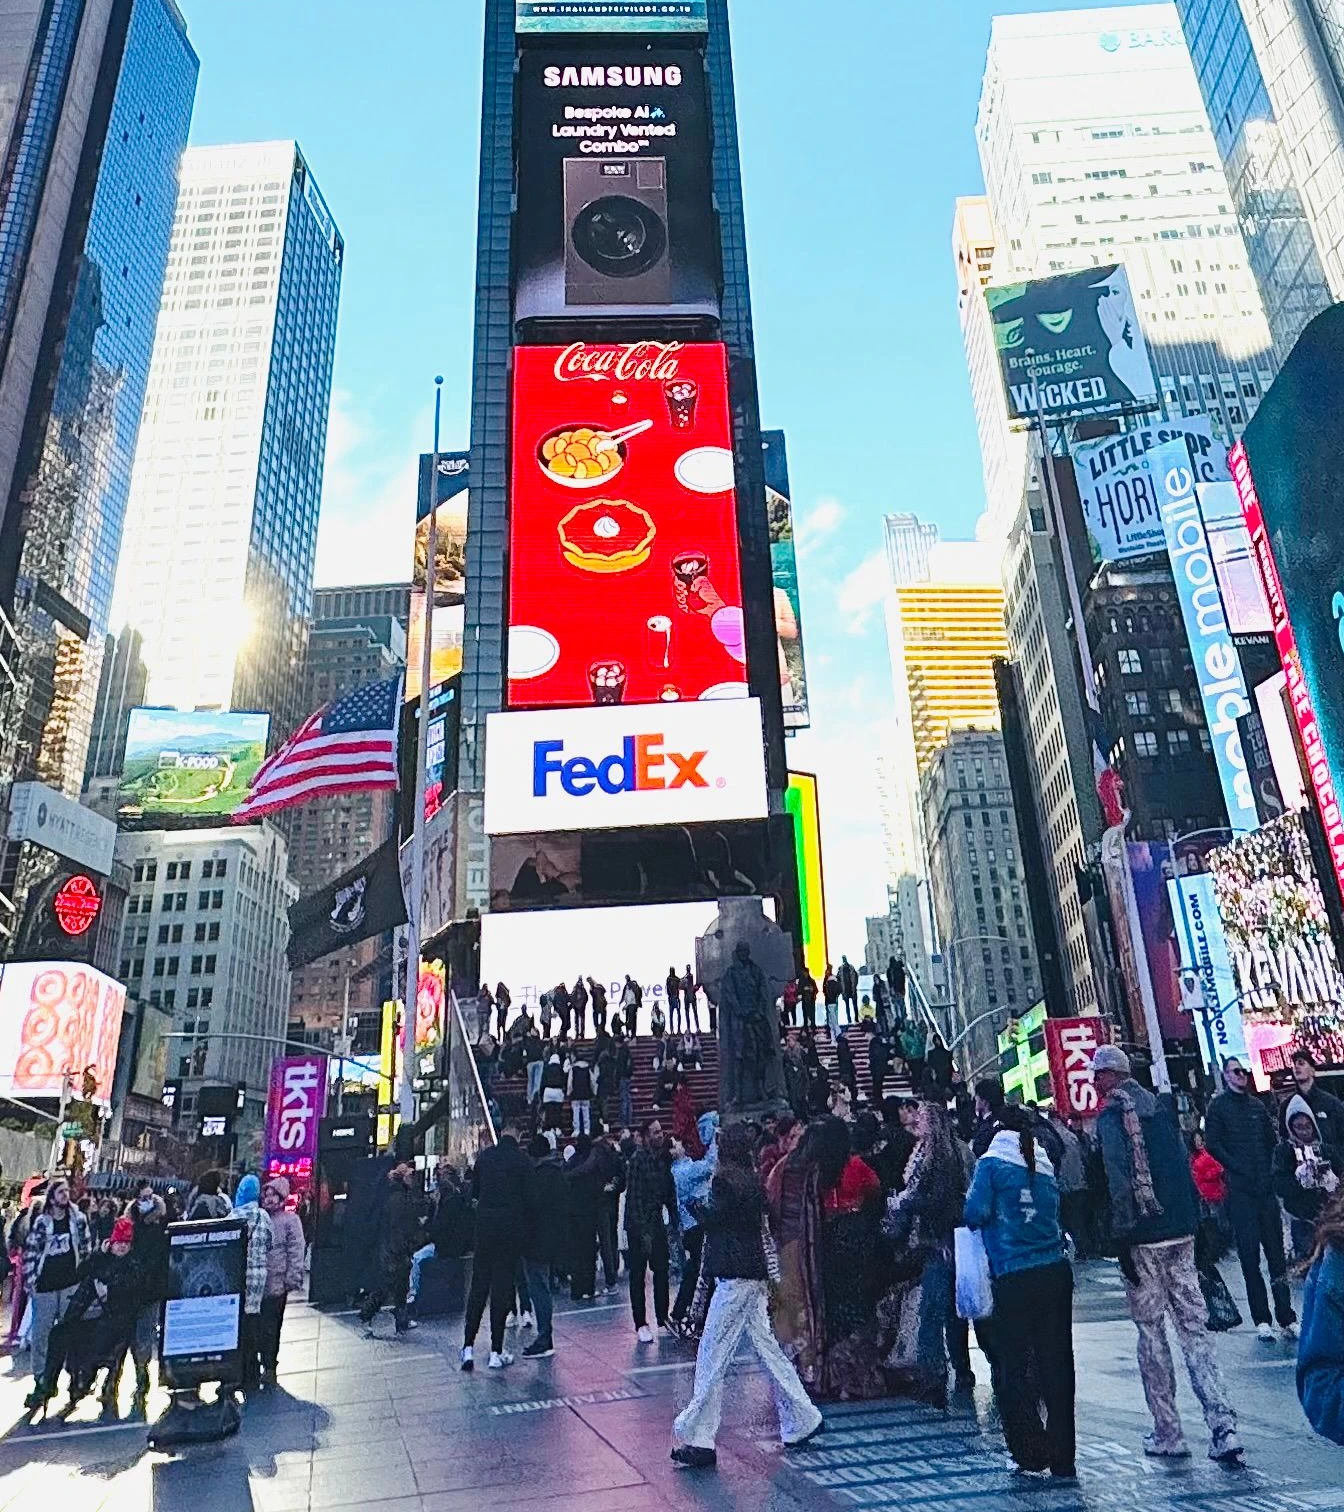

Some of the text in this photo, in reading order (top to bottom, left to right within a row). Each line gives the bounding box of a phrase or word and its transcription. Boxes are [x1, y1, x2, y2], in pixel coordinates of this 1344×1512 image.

[543, 66, 683, 88] SAMSUNG
[552, 123, 677, 141] Laundry Vented
[564, 105, 633, 122] Bespoke
[553, 340, 685, 382] Coca-Cola
[1056, 344, 1097, 362] Heart.
[1088, 430, 1153, 481] LITTLE
[1233, 635, 1270, 646] KEVANI
[533, 732, 710, 797] FedEx
[1235, 932, 1340, 1009] KEVANI
[1060, 1023, 1098, 1112] tkts
[278, 1061, 318, 1150] tkts
